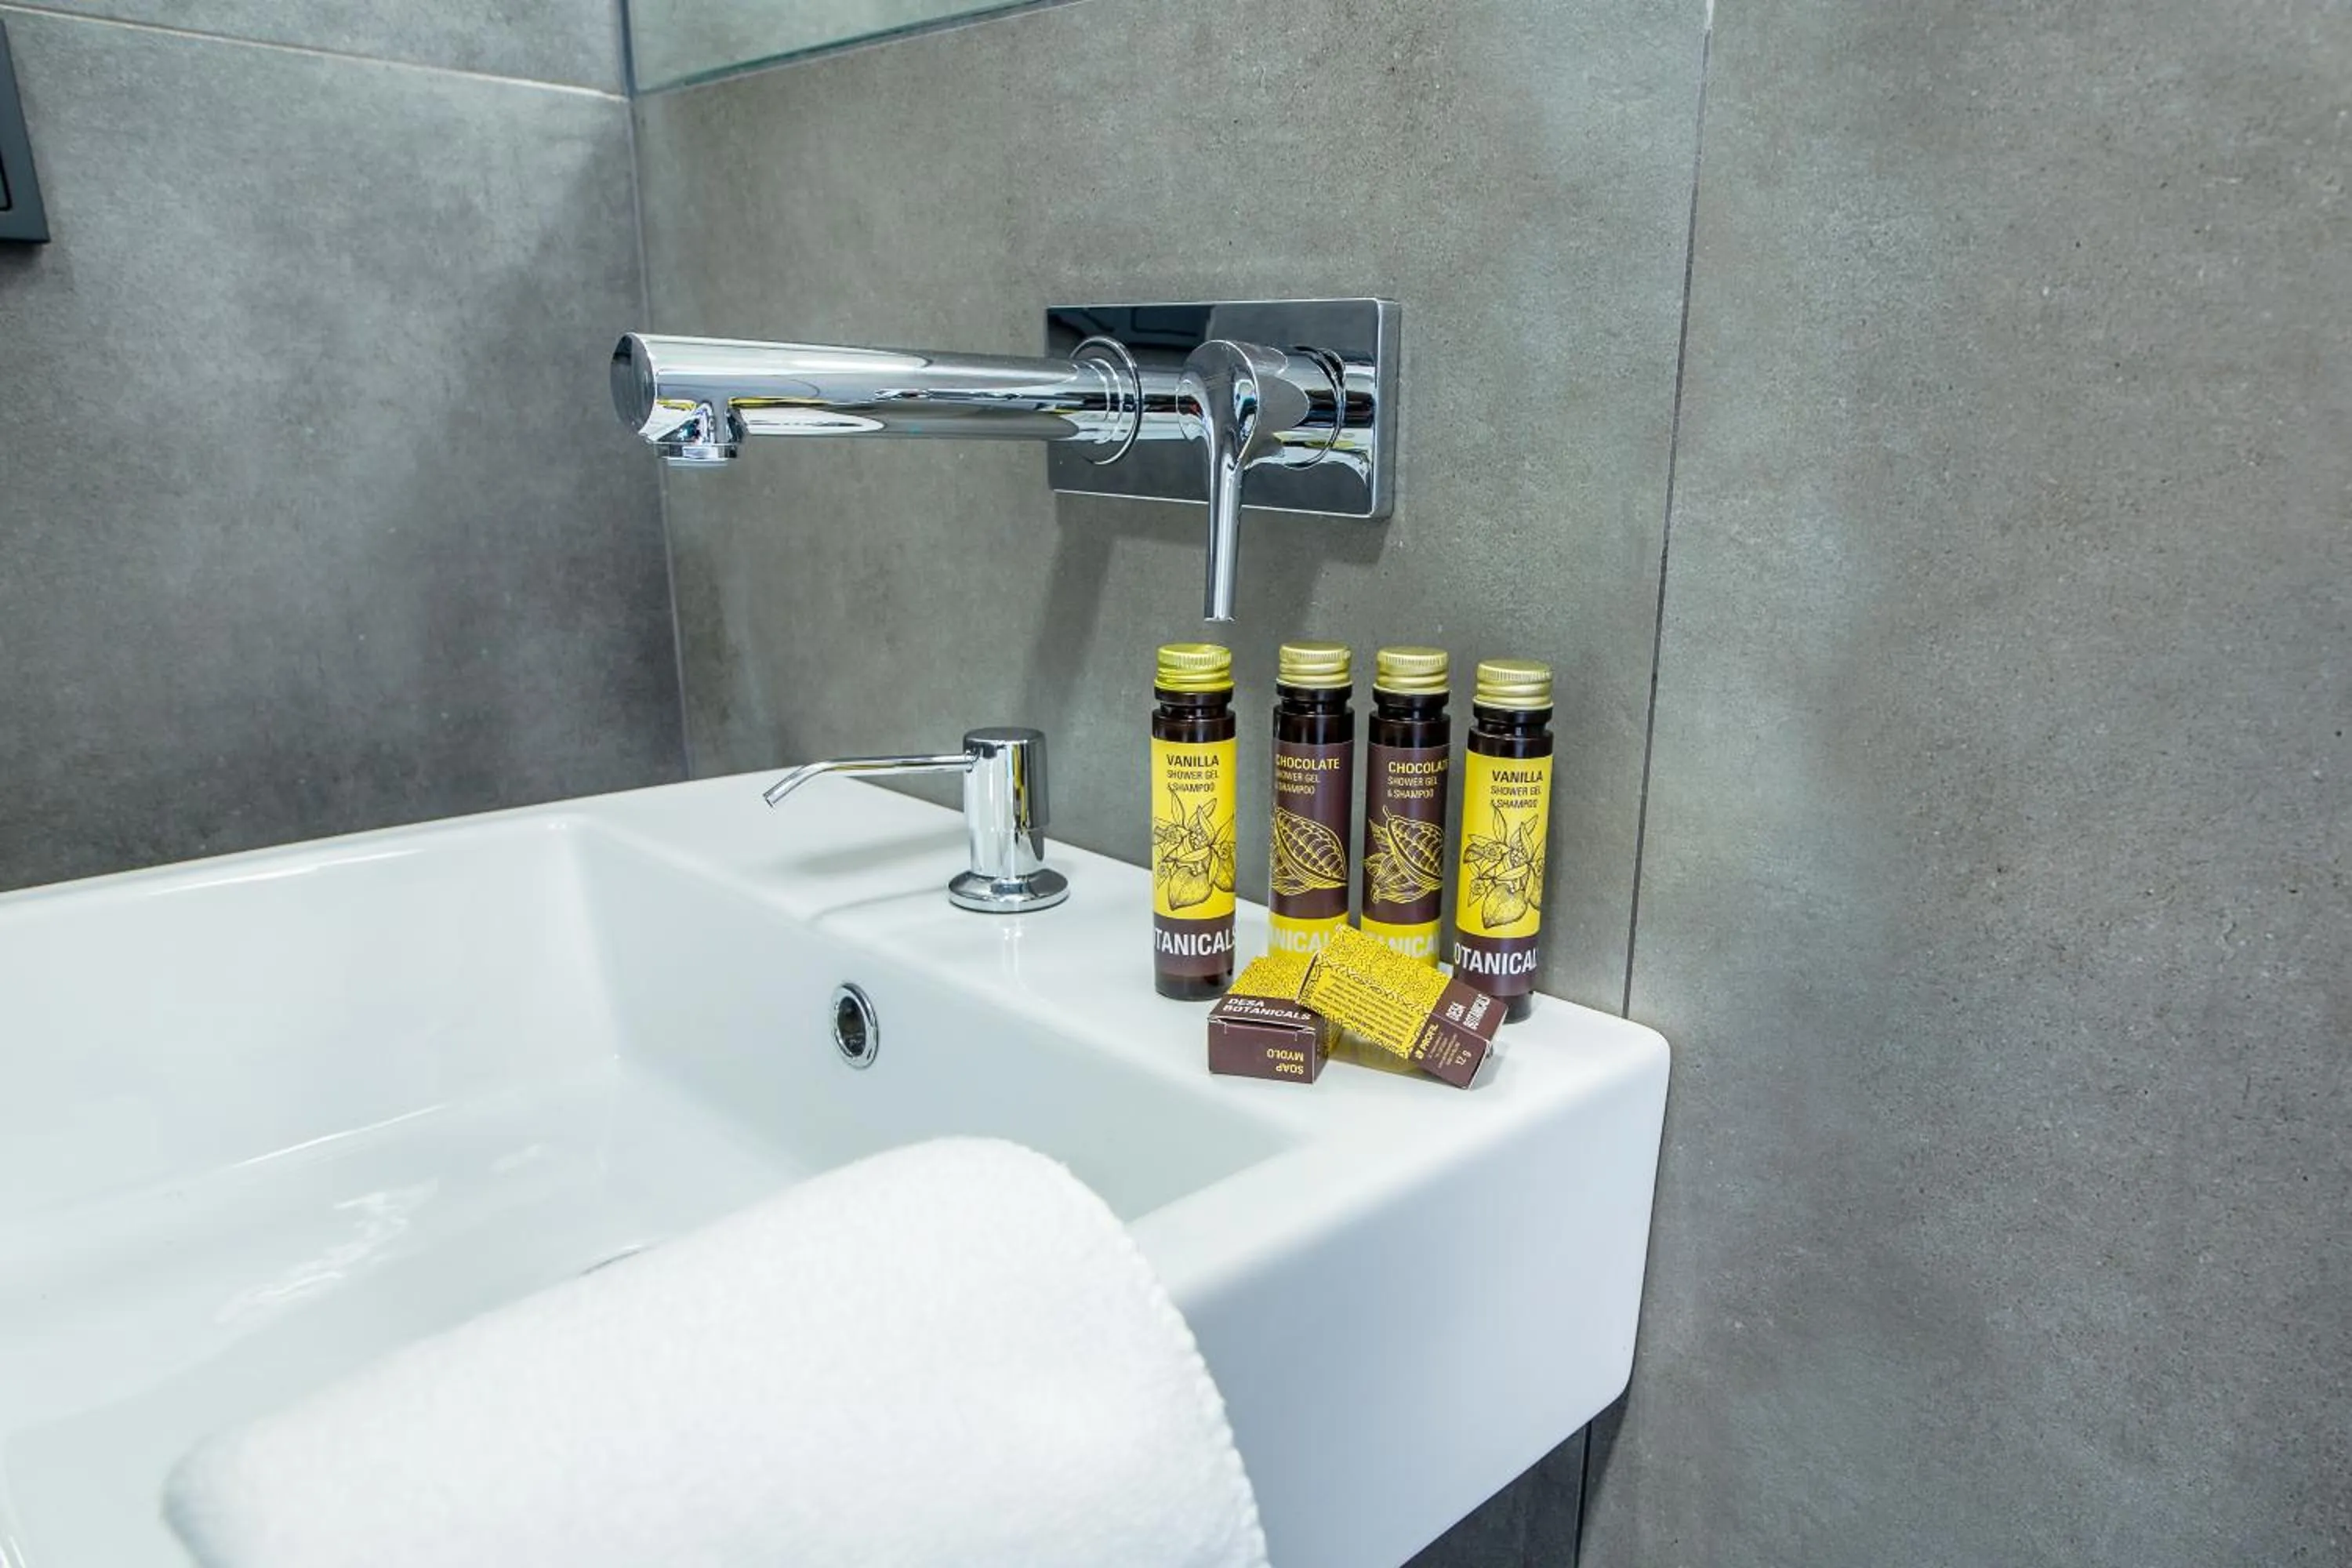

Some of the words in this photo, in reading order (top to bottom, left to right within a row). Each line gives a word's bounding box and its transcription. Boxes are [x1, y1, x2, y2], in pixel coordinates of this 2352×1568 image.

[1167, 754, 1219, 768] VANILLA
[1167, 769, 1203, 780] SHOWER
[1205, 769, 1219, 779] GEL
[1305, 773, 1321, 783] GEL
[1492, 770, 1543, 782] VANILLA
[1388, 775, 1424, 786] SHOWER
[1425, 775, 1438, 786] GEL
[1490, 786, 1528, 796] SHOWER
[1223, 1004, 1312, 1020] BOTANICALS
[1276, 1063, 1304, 1075] SOAP
